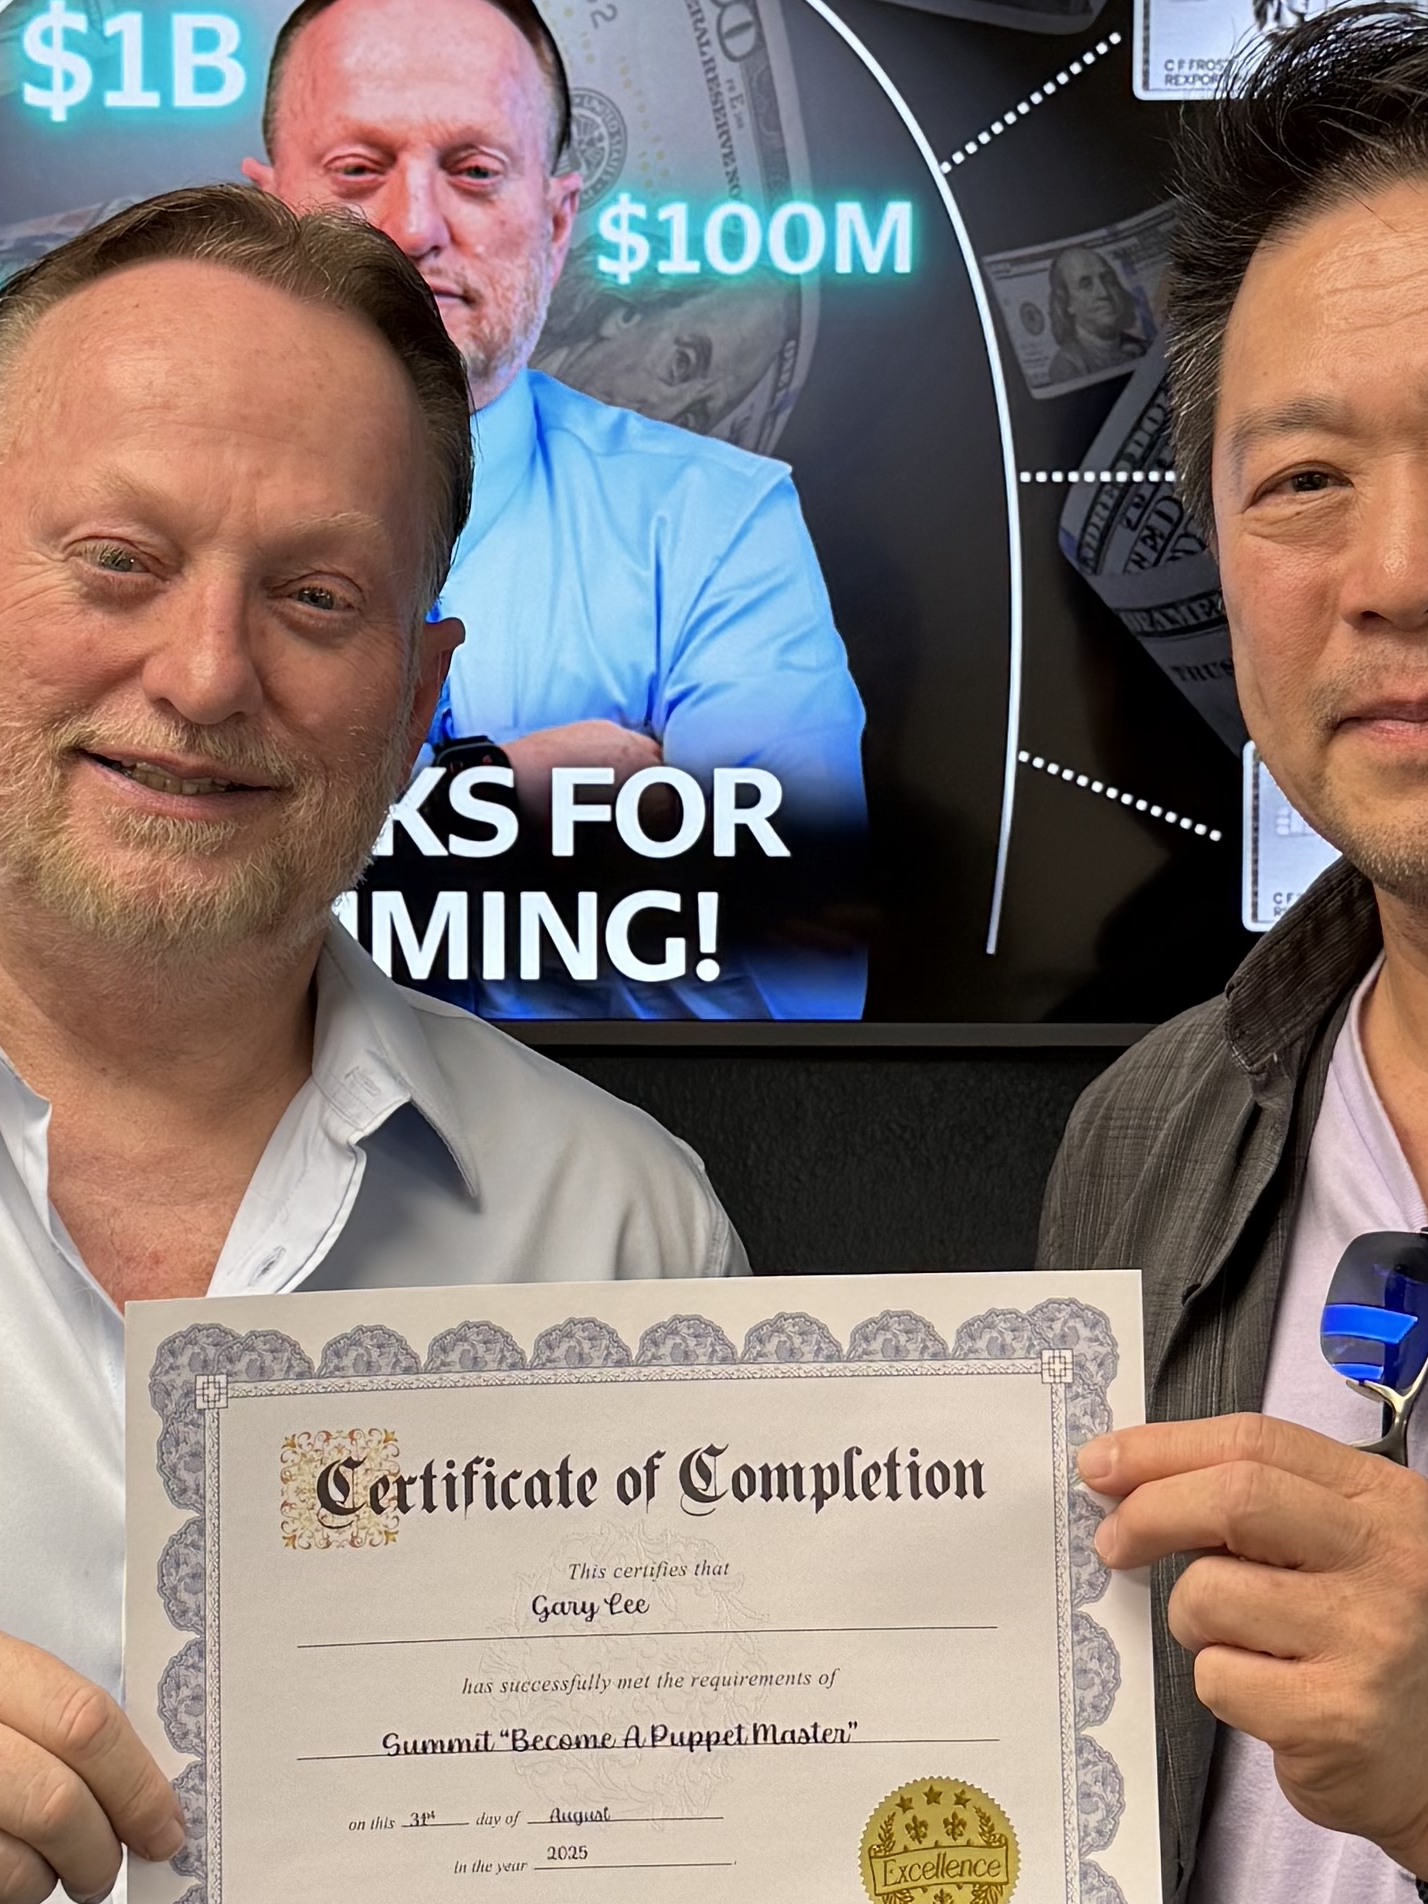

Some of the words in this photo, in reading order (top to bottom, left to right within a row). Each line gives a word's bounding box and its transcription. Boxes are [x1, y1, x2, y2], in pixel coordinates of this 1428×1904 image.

[22, 0, 247, 121] $1B
[1164, 58, 1175, 72] C
[1178, 58, 1186, 72] F
[597, 193, 912, 284] $100M
[551, 765, 792, 858] FOR
[316, 1453, 599, 1529] Certificate
[616, 1449, 667, 1514] of
[679, 1443, 988, 1517] Completion
[569, 1562, 606, 1580] This
[613, 1561, 688, 1582] certifies
[694, 1559, 730, 1576] that
[531, 1594, 600, 1623] Gary
[603, 1592, 650, 1615] Lee
[462, 1677, 493, 1695] has
[500, 1673, 611, 1696] successfully
[616, 1674, 651, 1689] met
[656, 1671, 685, 1689] the
[690, 1671, 811, 1692] requirements
[817, 1668, 841, 1690] of
[382, 1730, 495, 1757] Summit
[622, 1724, 646, 1749] A
[650, 1723, 749, 1752] Puppet
[348, 1820, 366, 1831] on
[370, 1816, 396, 1830] this
[475, 1811, 502, 1829] day
[504, 1810, 522, 1829] of
[549, 1806, 612, 1826] August
[472, 1859, 493, 1873] the
[495, 1861, 529, 1876] year
[546, 1845, 588, 1861] 2025
[882, 1851, 1002, 1887] Excellence
